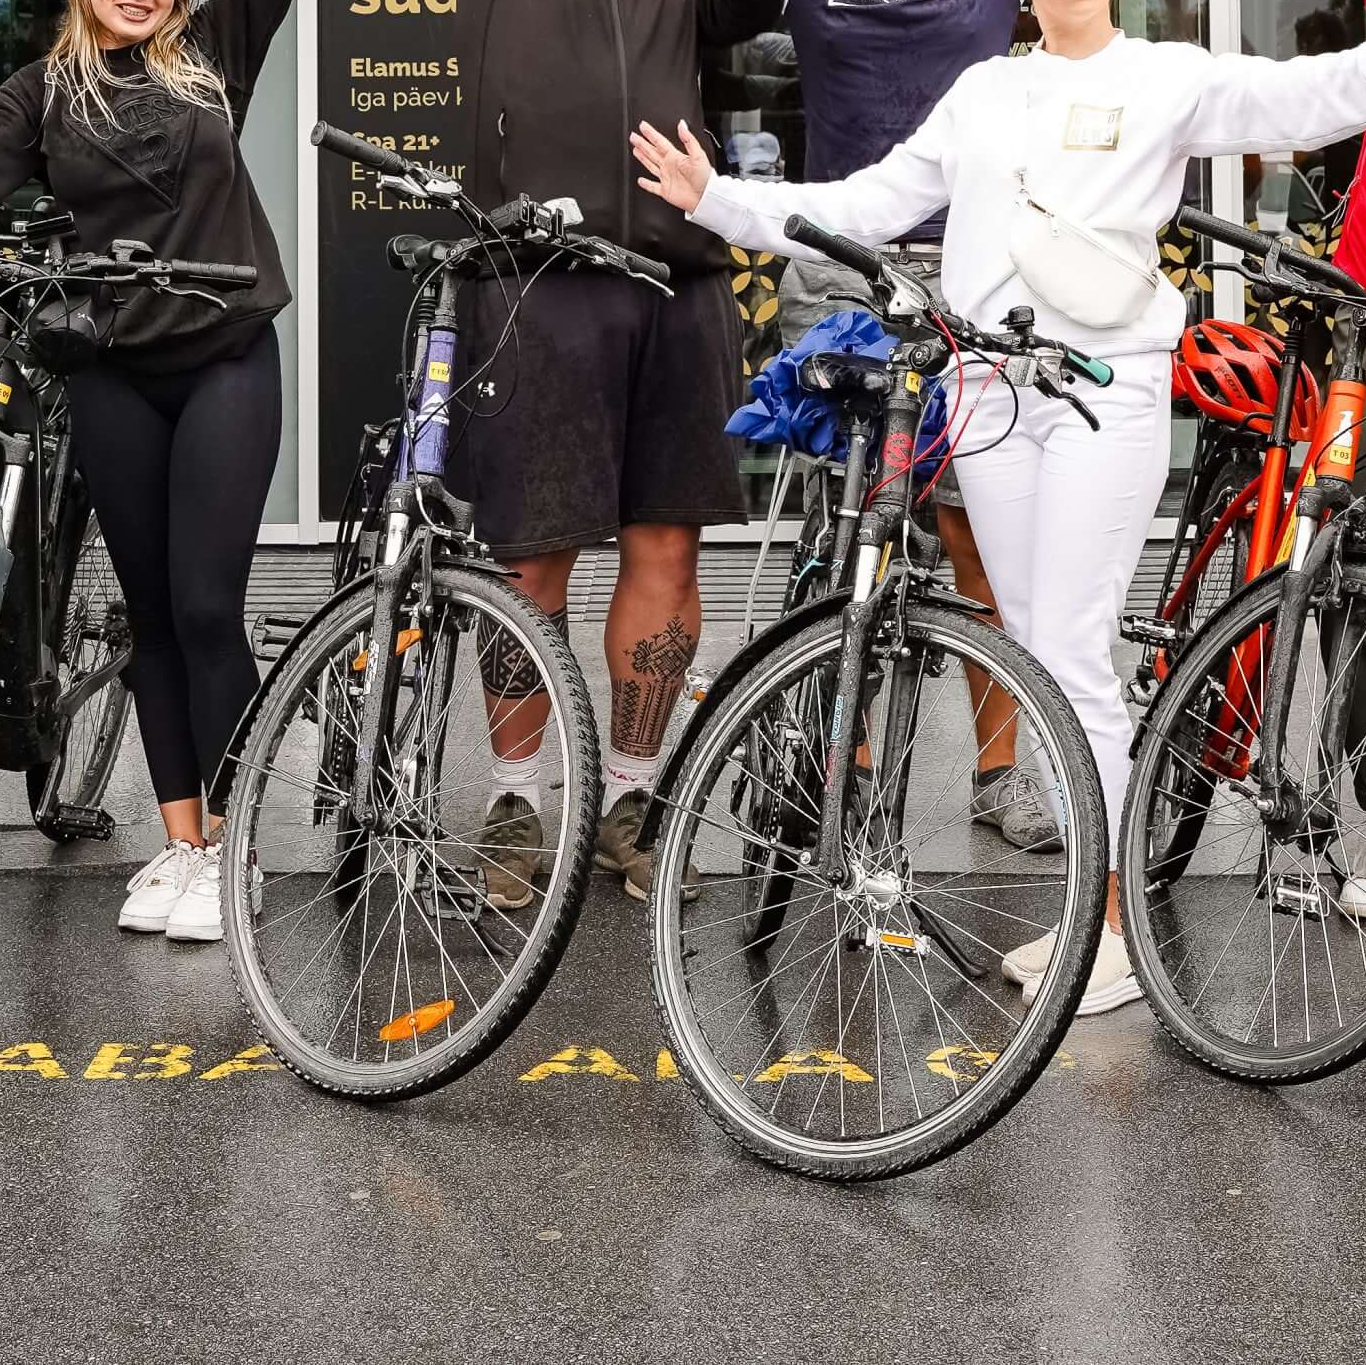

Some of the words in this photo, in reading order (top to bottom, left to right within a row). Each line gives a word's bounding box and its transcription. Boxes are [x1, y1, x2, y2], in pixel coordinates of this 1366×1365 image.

[351, 58, 441, 78] Elamus
[351, 87, 385, 112] Iga
[393, 87, 450, 112] päev
[402, 135, 440, 151] 21+
[352, 190, 393, 210] R-L
